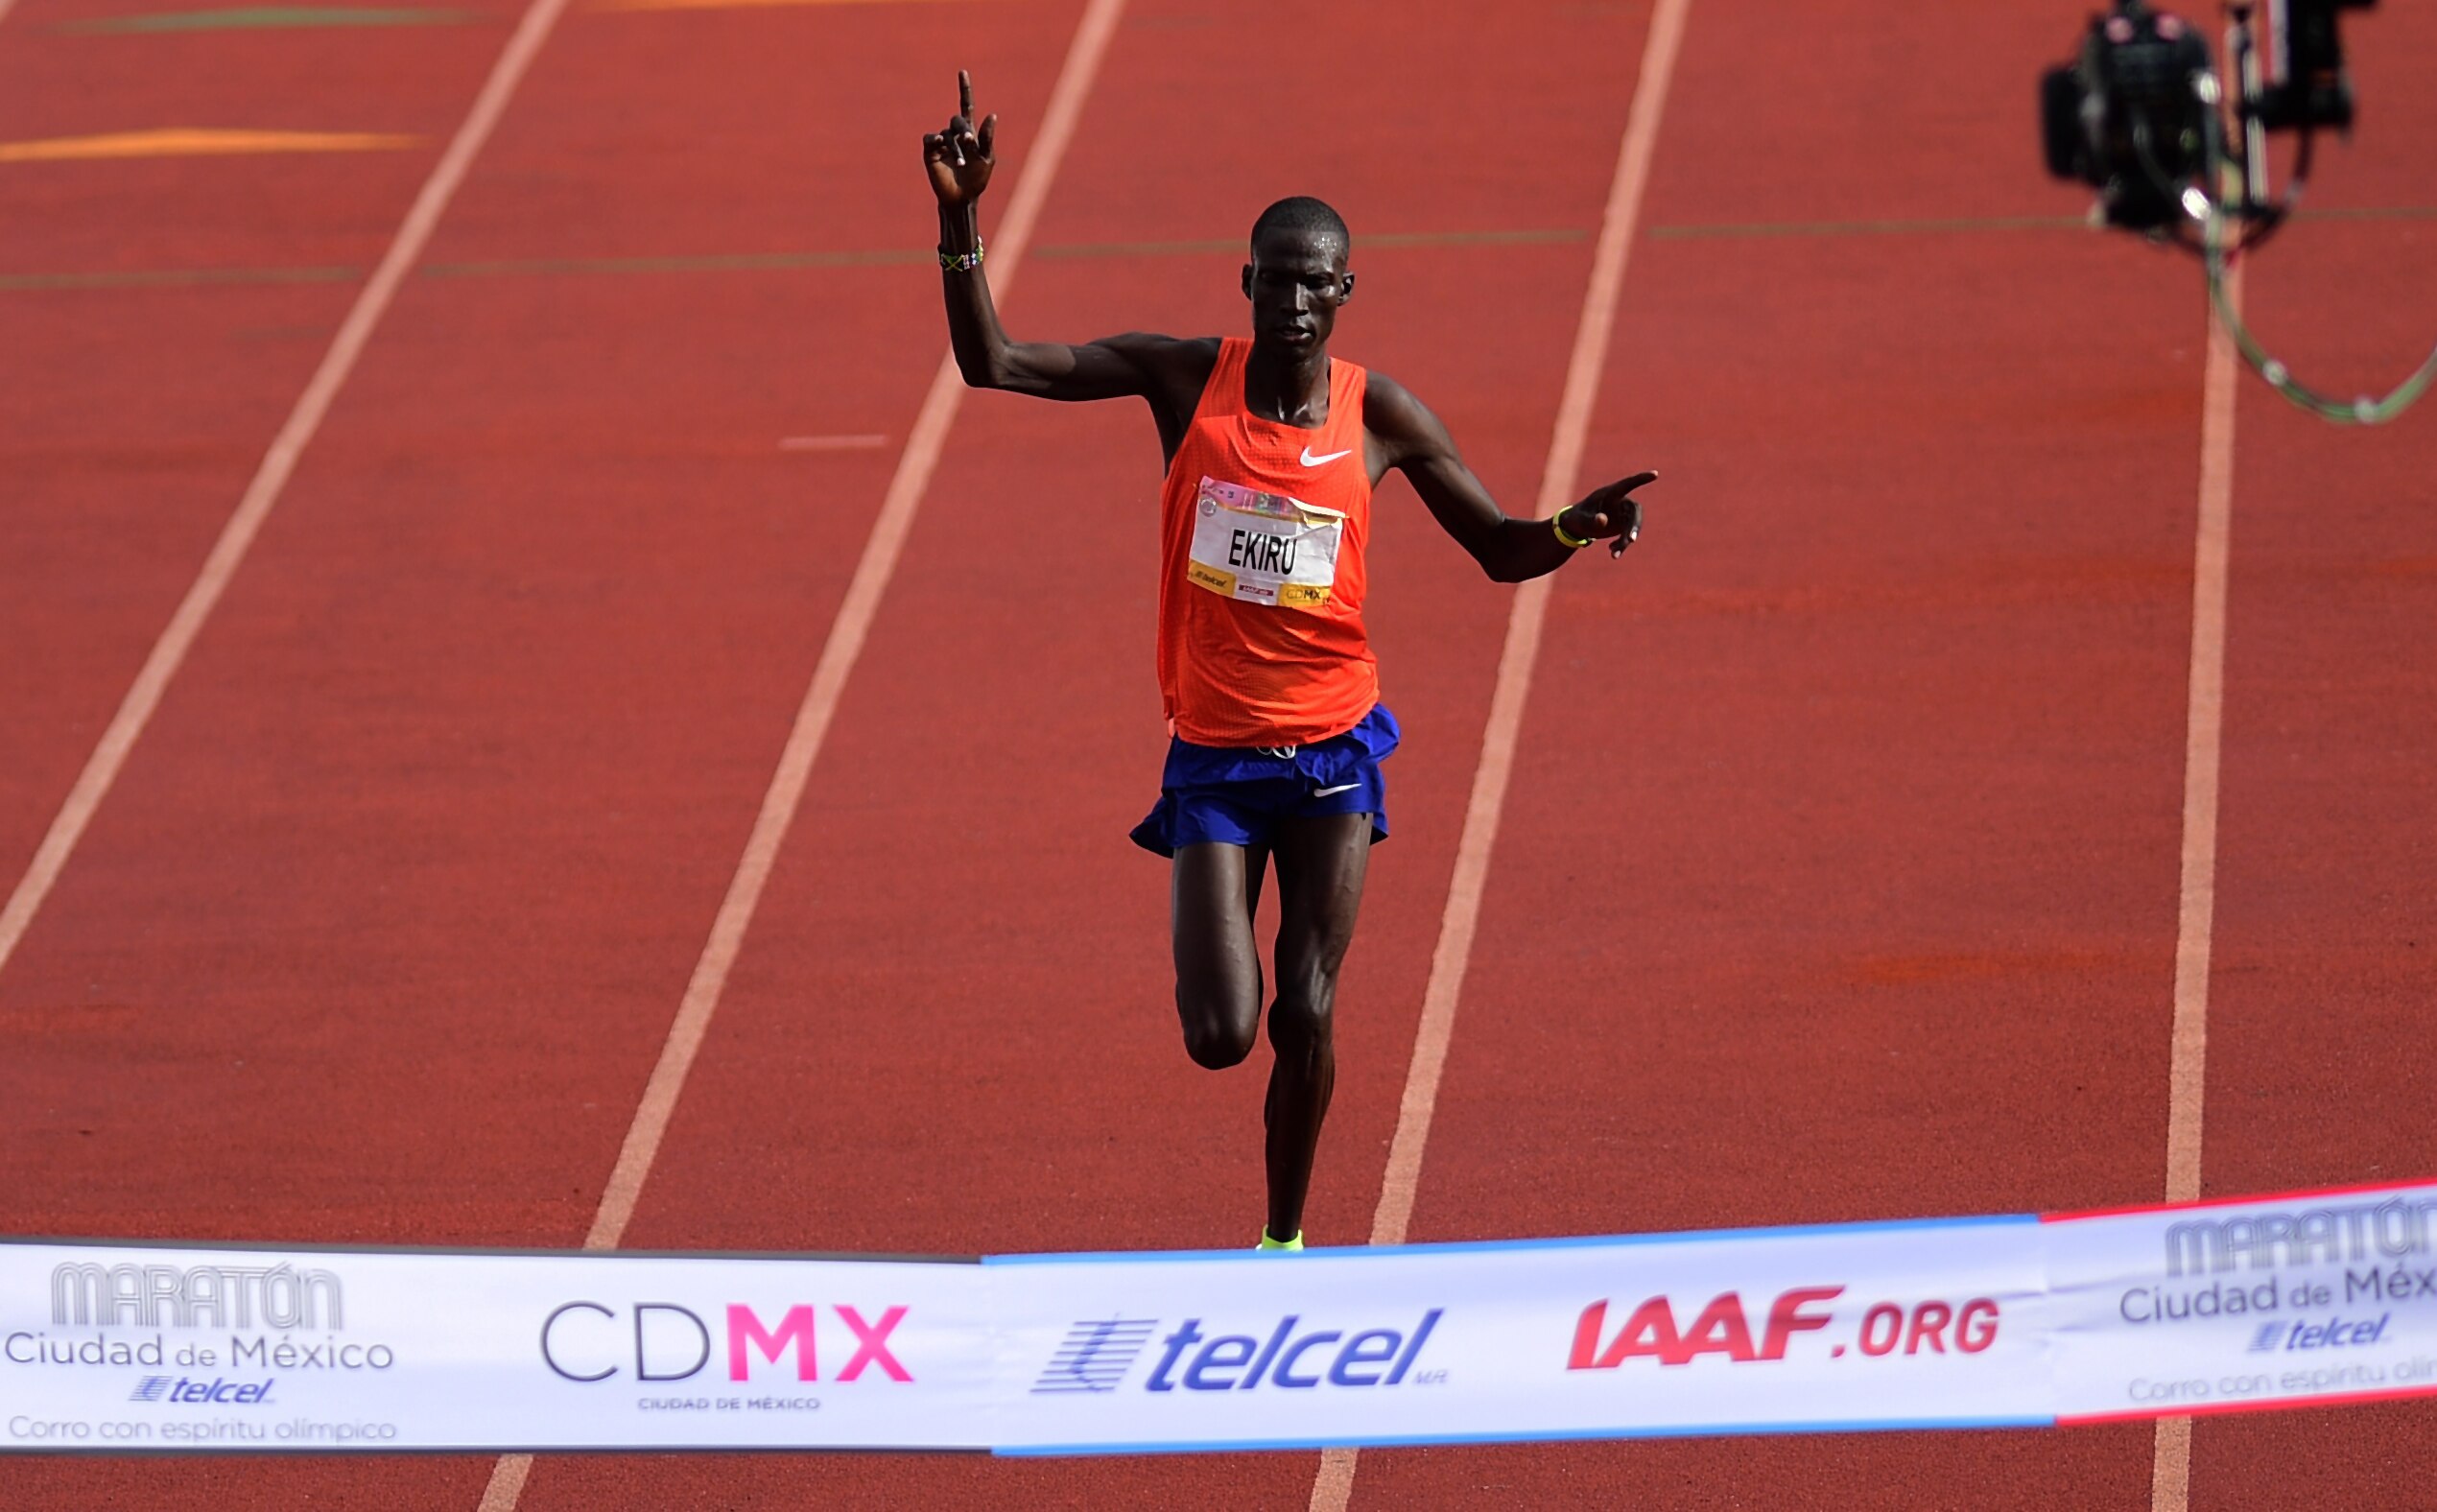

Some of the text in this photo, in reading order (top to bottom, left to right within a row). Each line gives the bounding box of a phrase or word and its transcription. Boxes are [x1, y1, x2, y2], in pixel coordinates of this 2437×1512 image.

[1228, 529, 1297, 576] EKIRU
[2119, 1262, 2437, 1324] Ciudad de Méx
[540, 1300, 914, 1382] CDMX
[1567, 1285, 2000, 1370] IAAF.ORG
[2286, 1311, 2390, 1351] telcel
[5, 1332, 393, 1369] Ciudad de México
[1145, 1308, 1445, 1392] telcel
[168, 1377, 274, 1403] telcel
[638, 1395, 820, 1410] CIUDAD DE MÉXICO
[2128, 1378, 2210, 1401] Corro
[2218, 1373, 2271, 1395] con
[9, 1415, 396, 1443] Corro con espíritu olímpico
